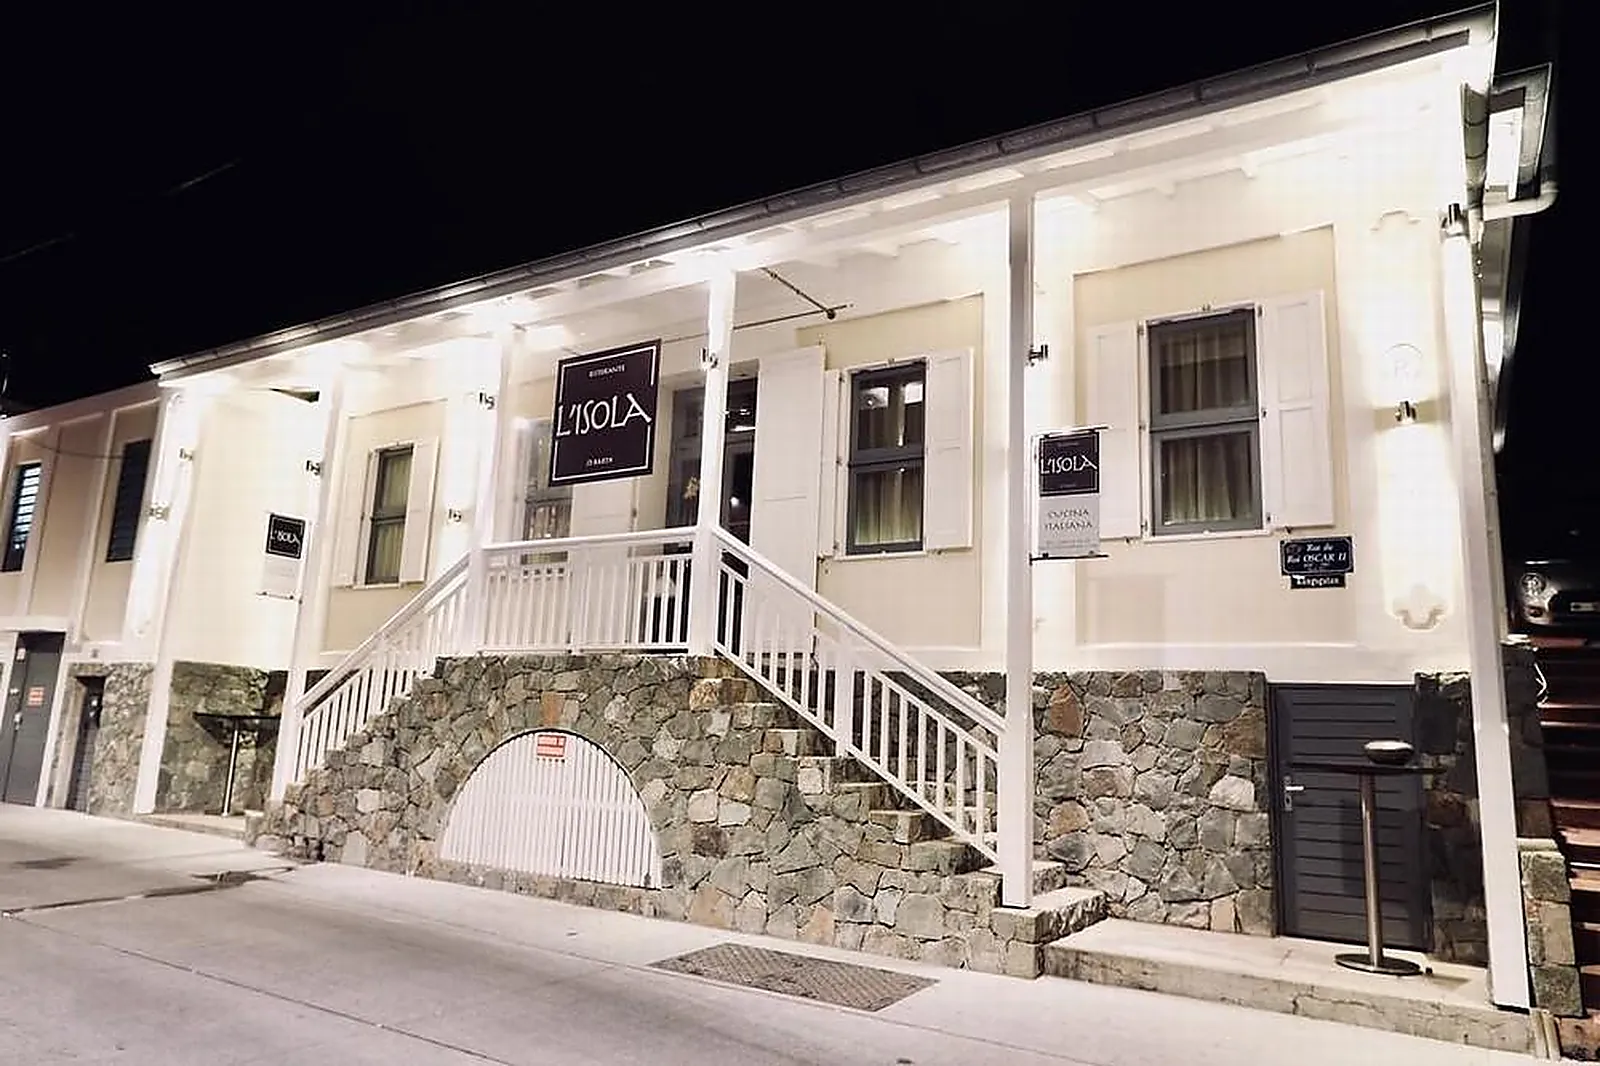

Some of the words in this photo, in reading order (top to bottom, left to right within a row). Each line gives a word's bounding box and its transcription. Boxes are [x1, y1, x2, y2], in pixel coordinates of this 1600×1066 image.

[556, 393, 652, 437] L'ISOLA
[1040, 455, 1098, 474] L'ISOLA
[1303, 552, 1335, 563] OSCAR
